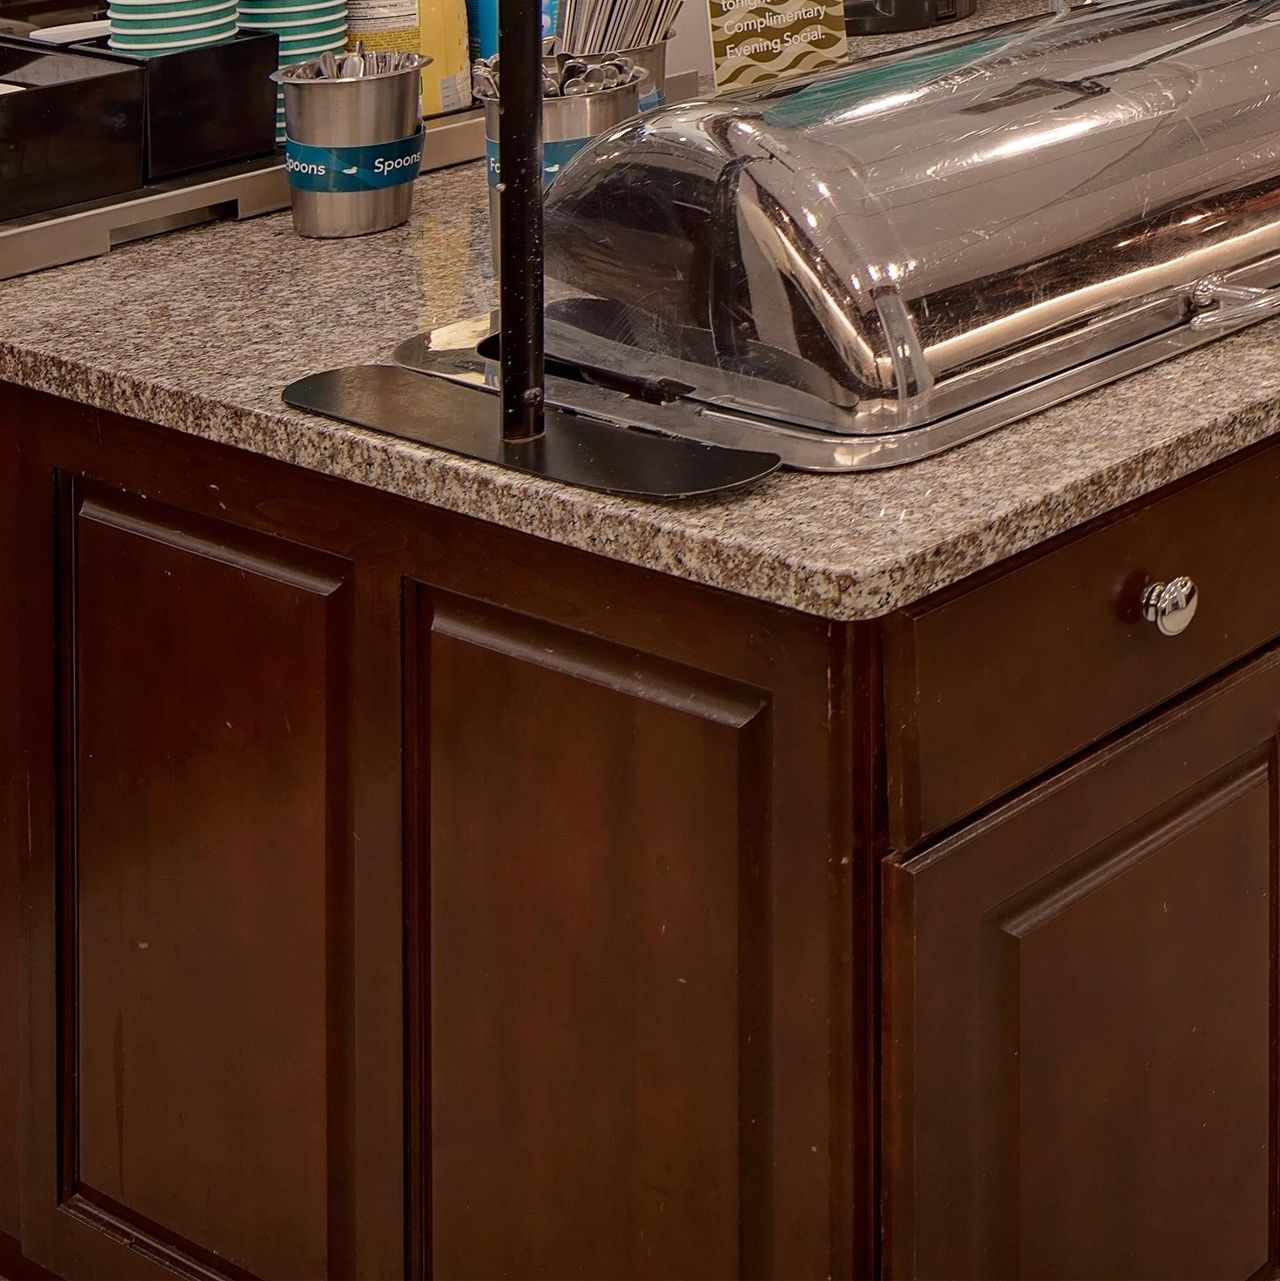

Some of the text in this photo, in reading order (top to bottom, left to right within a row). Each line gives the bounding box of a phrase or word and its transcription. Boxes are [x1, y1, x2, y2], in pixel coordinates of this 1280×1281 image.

[724, 4, 827, 35] Complimentary
[726, 24, 826, 59] Evening Social.
[373, 152, 421, 176] Spoons
